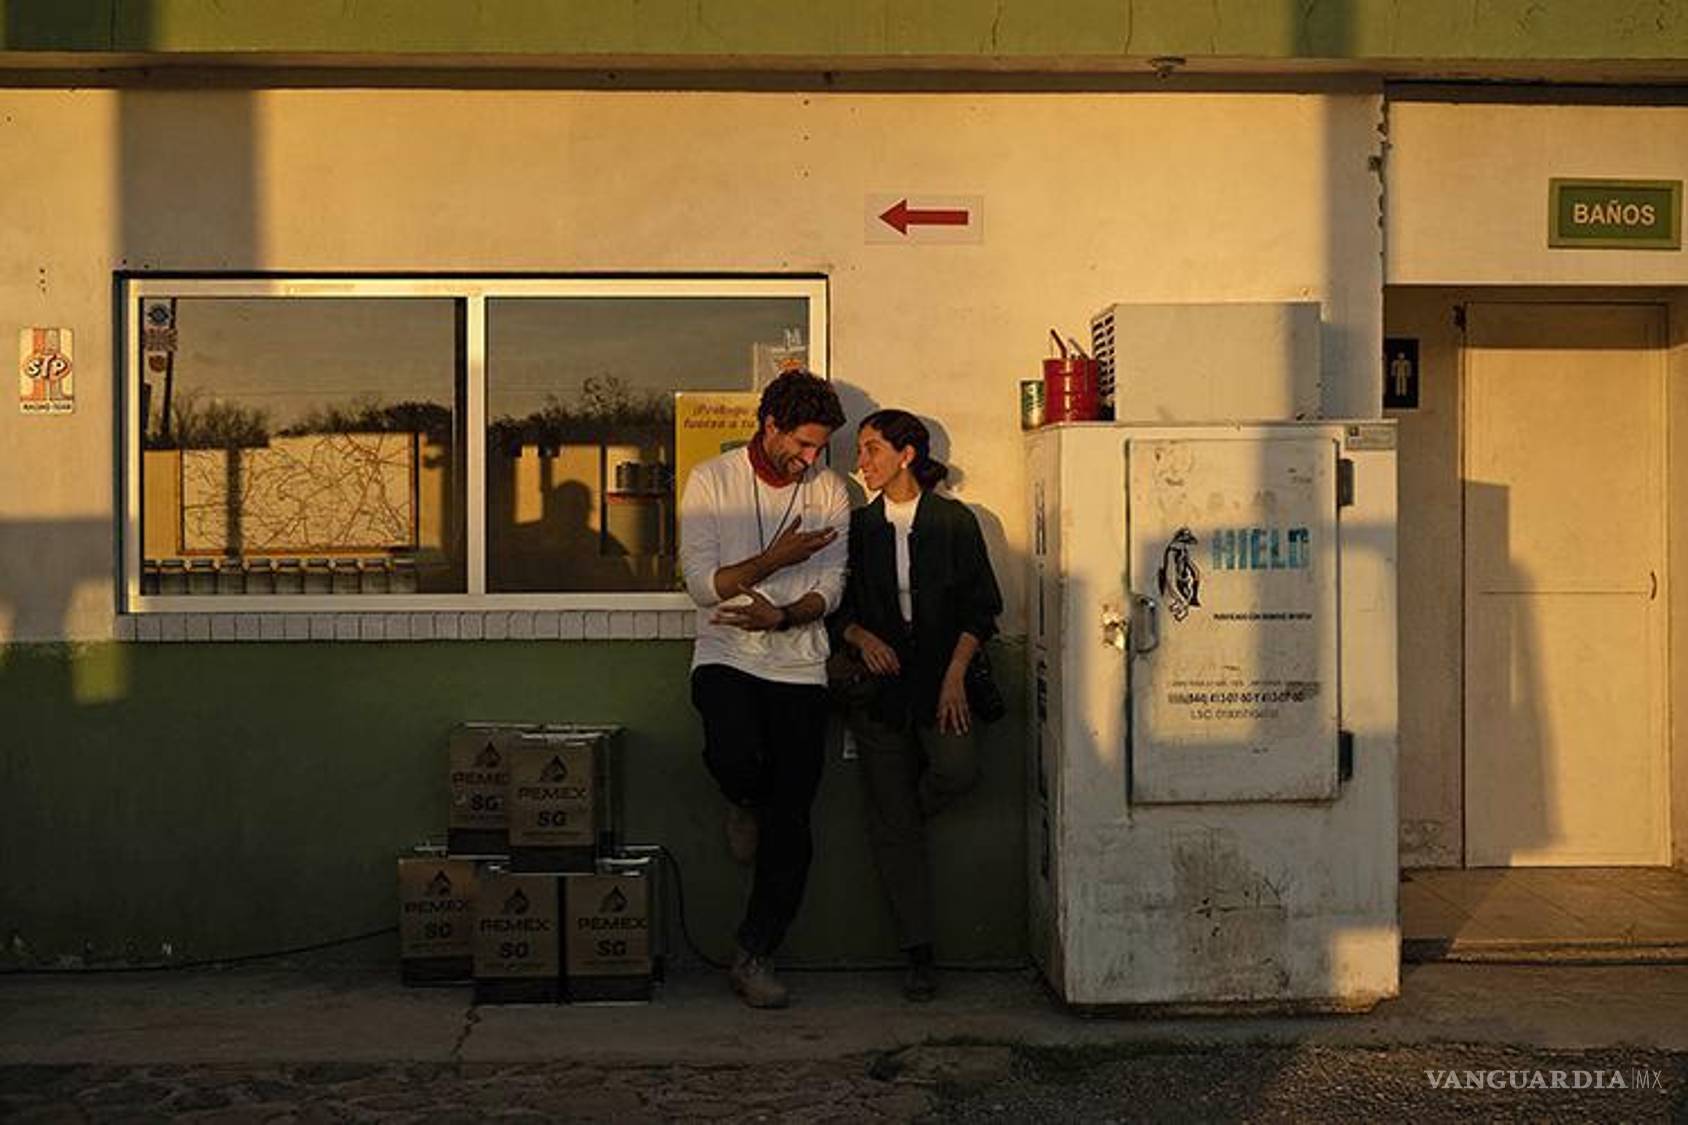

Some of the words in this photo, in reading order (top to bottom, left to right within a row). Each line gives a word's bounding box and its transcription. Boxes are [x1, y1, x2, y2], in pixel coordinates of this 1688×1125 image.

[1573, 199, 1656, 226] BAÑOS
[28, 353, 68, 379] STP
[1212, 526, 1310, 569] HIELO
[452, 771, 510, 785] PEME
[518, 786, 588, 800] PEMEX
[470, 794, 499, 812] SG
[537, 810, 568, 827] SG
[480, 918, 551, 932] PEMEX
[577, 917, 648, 931] PEMEX
[596, 940, 628, 958] SG
